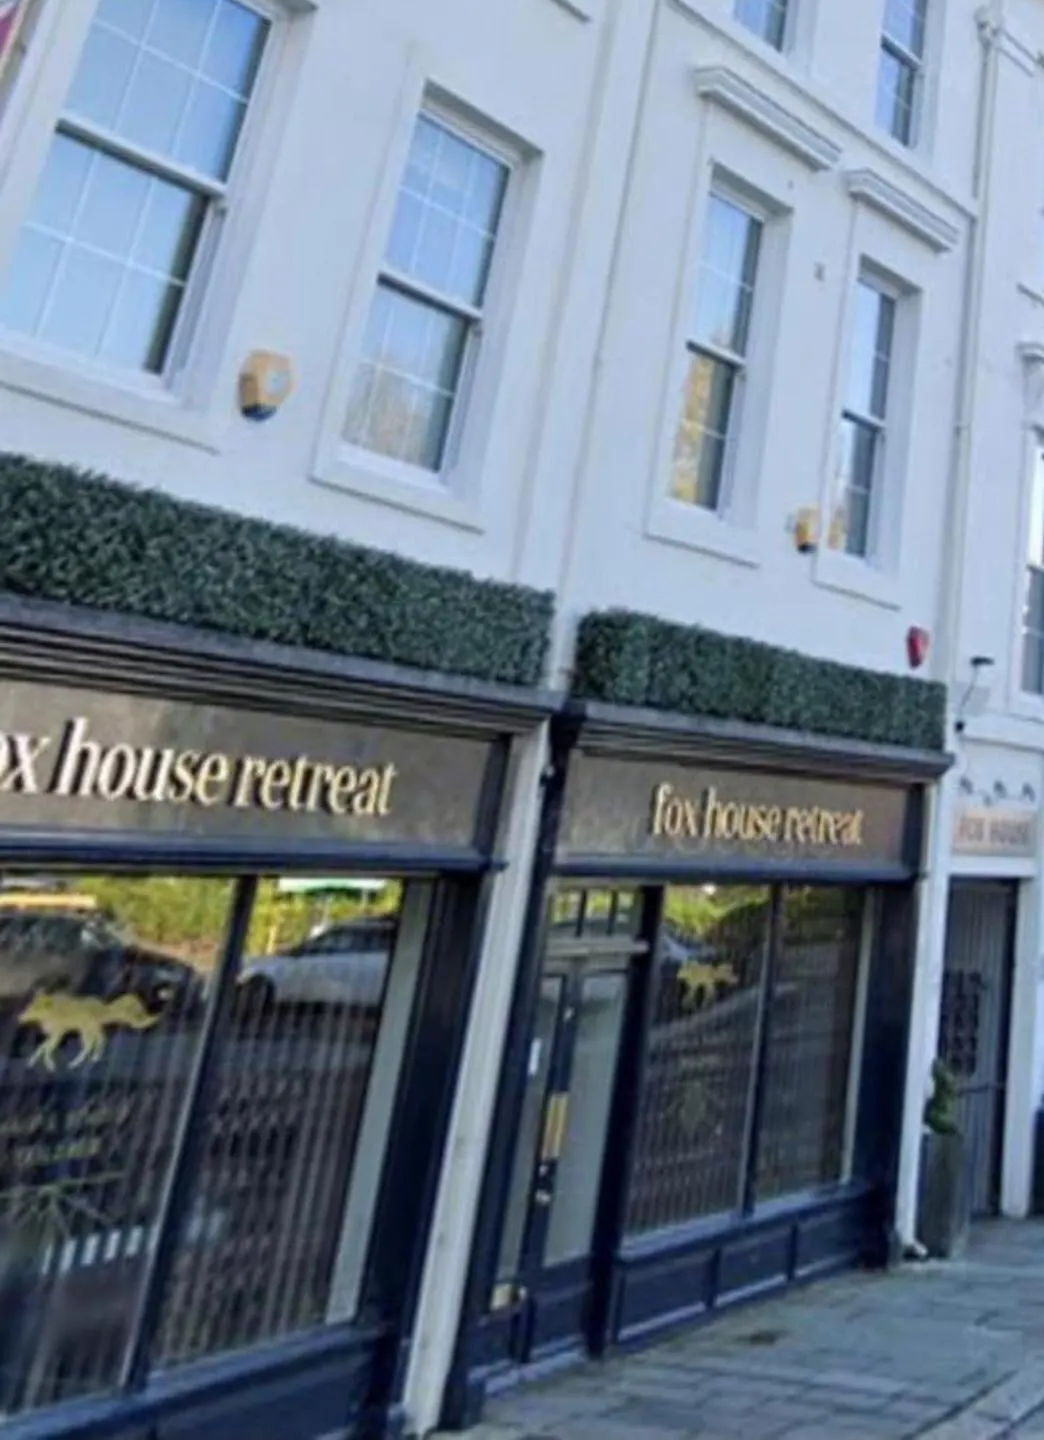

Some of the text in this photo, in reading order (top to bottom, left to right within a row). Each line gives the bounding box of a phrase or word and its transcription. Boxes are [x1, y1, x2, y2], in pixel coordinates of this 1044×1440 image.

[50, 715, 229, 807] house
[232, 750, 398, 817] retreat
[652, 781, 864, 846] fox house retreat
